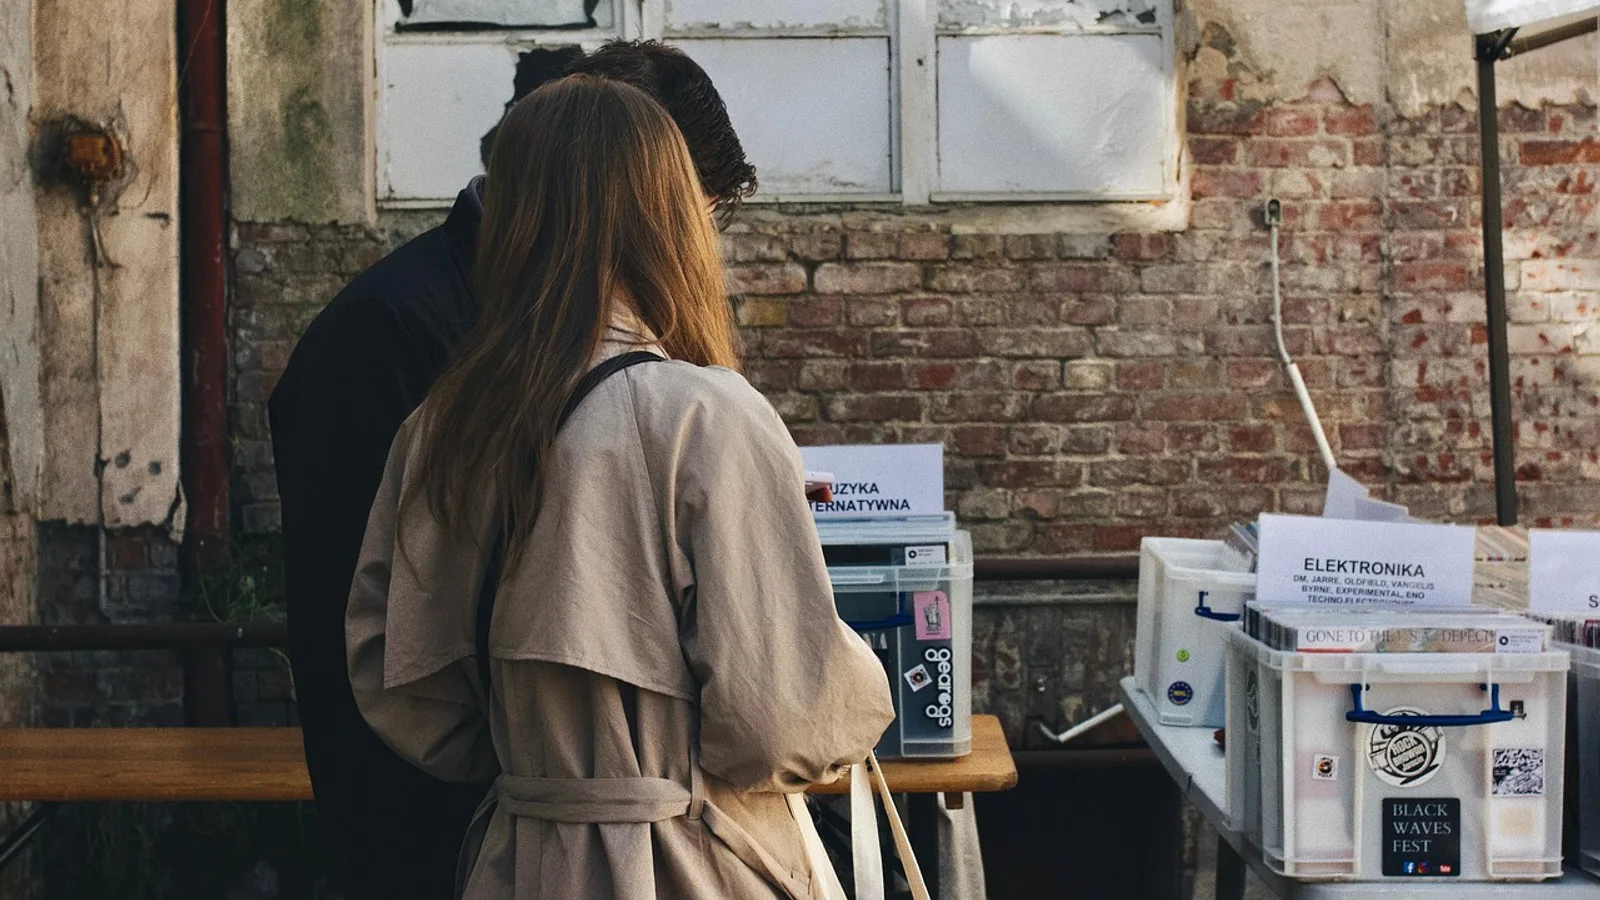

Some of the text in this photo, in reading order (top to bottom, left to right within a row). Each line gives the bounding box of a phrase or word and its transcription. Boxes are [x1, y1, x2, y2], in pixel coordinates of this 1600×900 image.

[829, 483, 879, 495] UZYKA
[808, 499, 910, 512] TERNATYWNA
[1304, 557, 1425, 578] ELEKTRONIKA
[1343, 577, 1389, 588] OLDFIELD,
[1391, 580, 1434, 590] VANGELIS
[1336, 586, 1403, 598] EXPERIMENTAL,
[1406, 591, 1425, 599] ENO
[1306, 629, 1344, 642] GONE
[1346, 629, 1366, 642] TO
[1393, 803, 1448, 816] BLACK
[1393, 821, 1452, 836] WAVES
[1393, 840, 1432, 853] FEST
